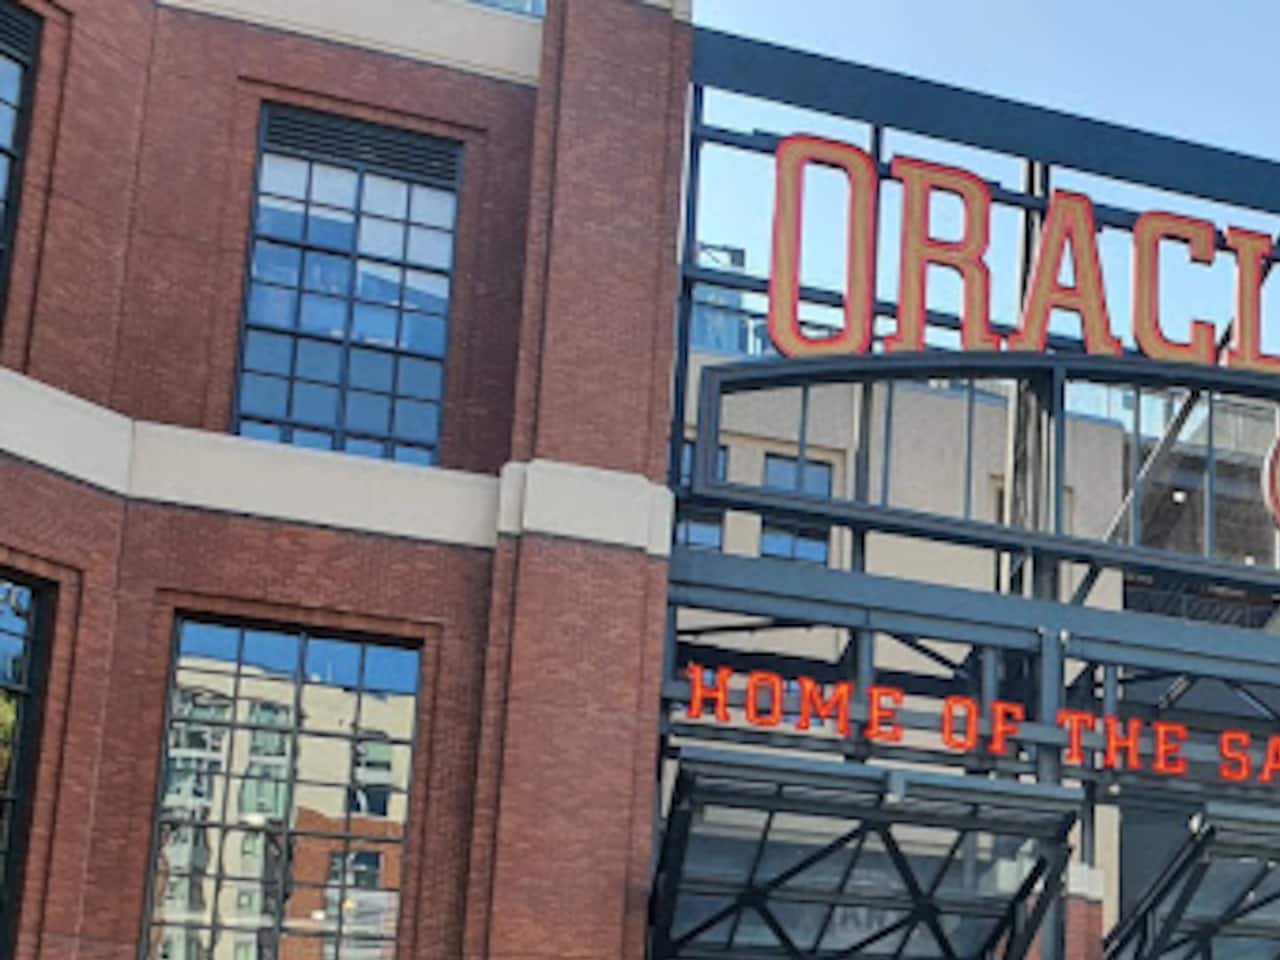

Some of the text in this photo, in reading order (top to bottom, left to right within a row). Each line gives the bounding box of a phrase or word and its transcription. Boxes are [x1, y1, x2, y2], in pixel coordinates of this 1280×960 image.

[684, 660, 905, 742] HOME
[940, 695, 1026, 756] OF
[1055, 708, 1189, 776] THE
